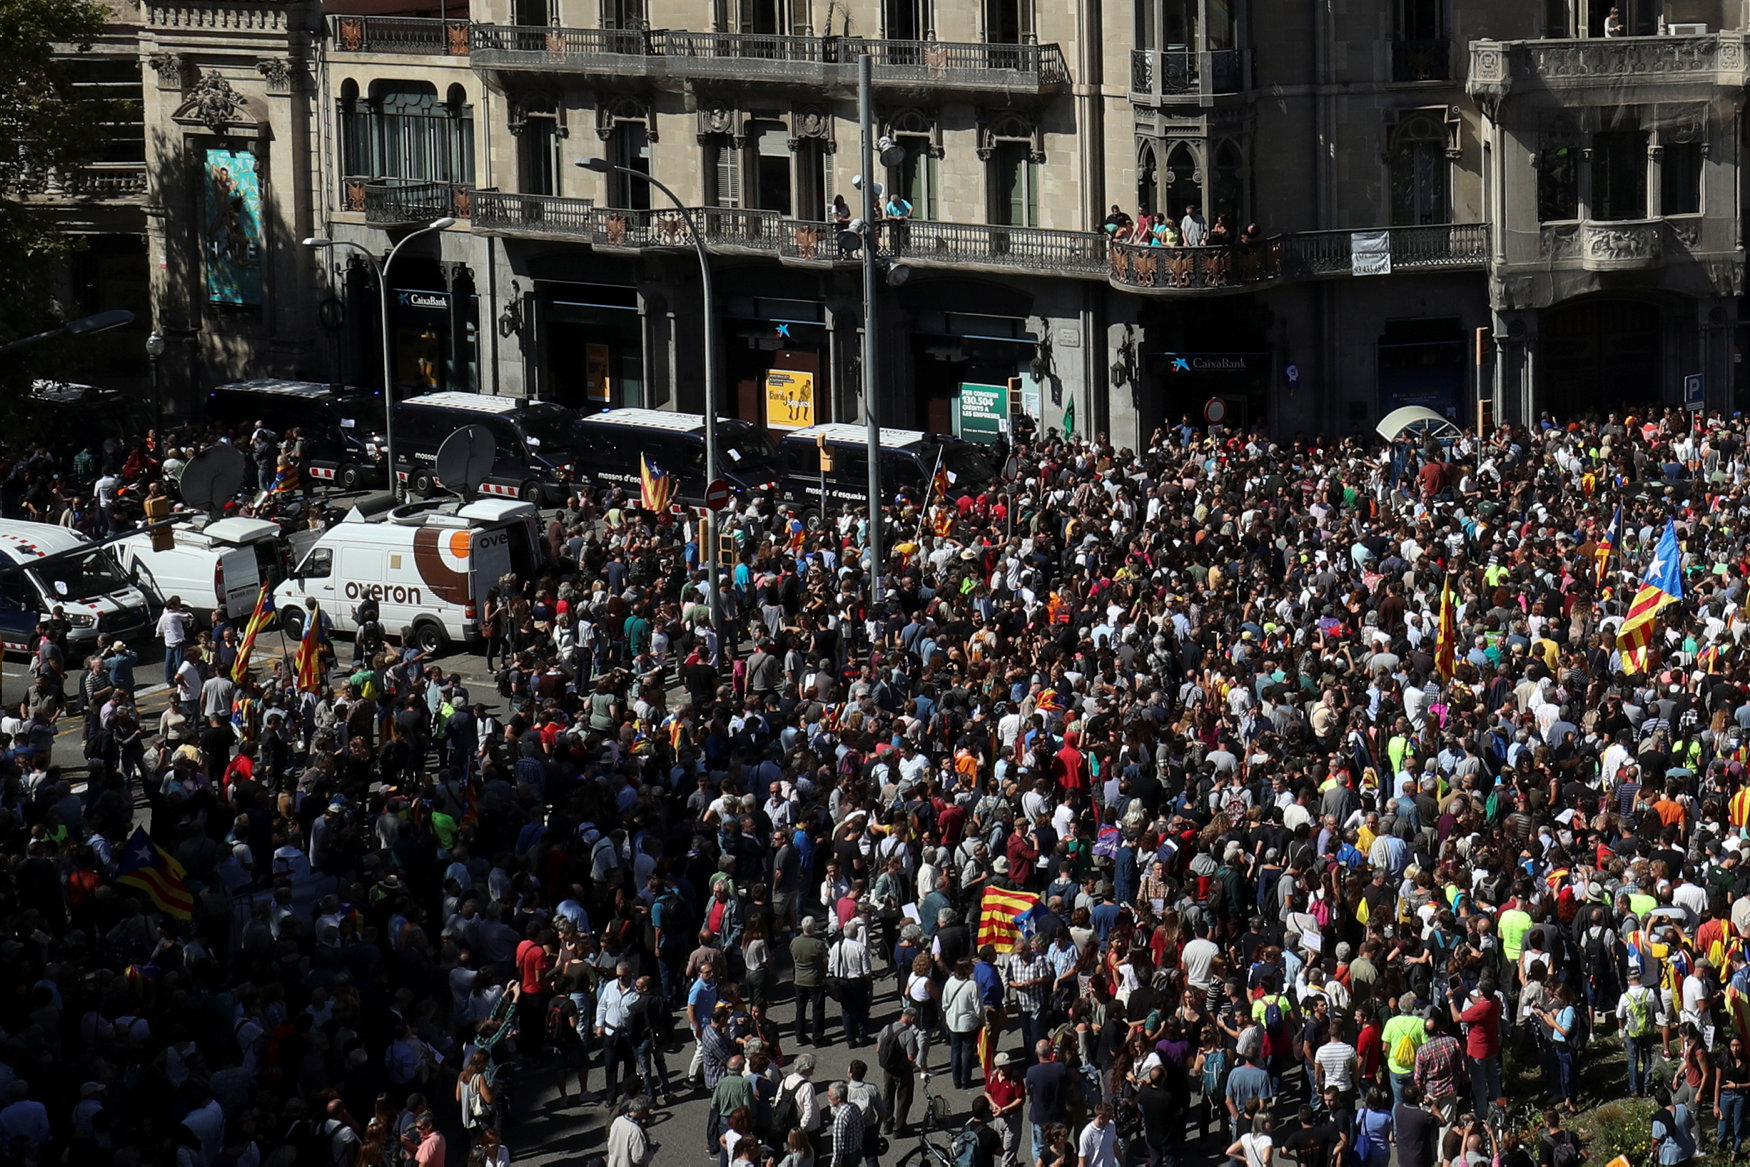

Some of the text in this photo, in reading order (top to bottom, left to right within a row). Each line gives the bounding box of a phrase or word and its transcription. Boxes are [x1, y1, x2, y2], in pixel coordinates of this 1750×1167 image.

[411, 294, 448, 307] CaixaBank
[1192, 357, 1247, 369] CaixaBank
[1689, 378, 1700, 399] P
[962, 395, 994, 407] 130.504
[598, 472, 622, 481] mossos
[623, 473, 641, 484] d'esq
[805, 487, 829, 496] mosss
[345, 582, 421, 605] overon
